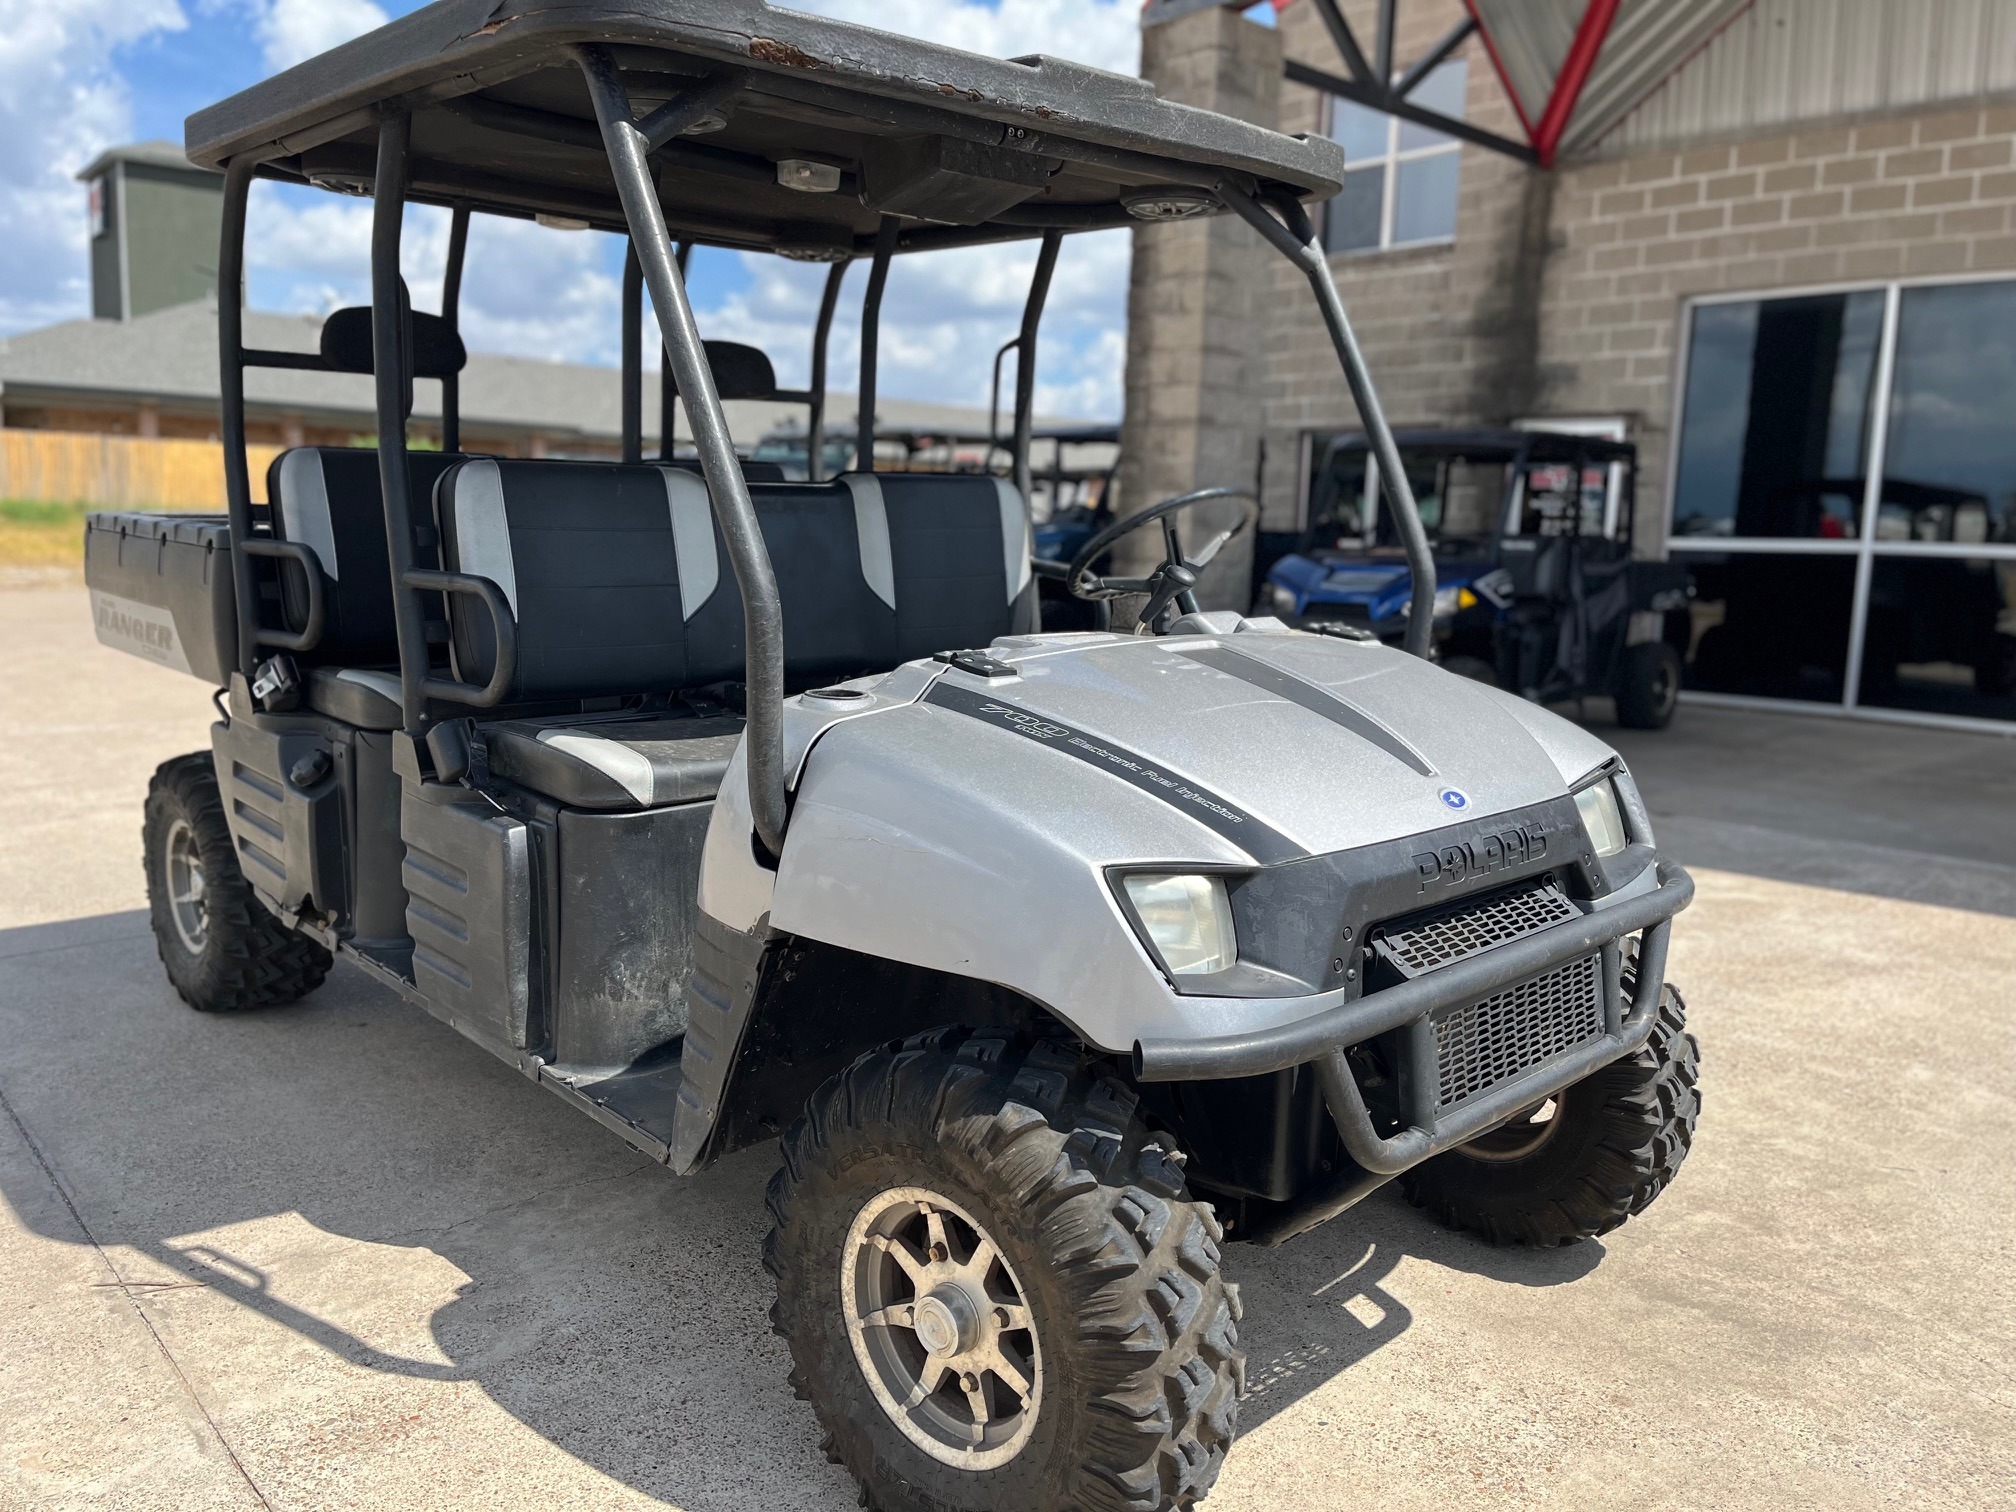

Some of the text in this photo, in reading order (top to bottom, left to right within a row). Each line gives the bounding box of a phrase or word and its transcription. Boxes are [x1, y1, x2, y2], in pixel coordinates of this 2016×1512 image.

[98, 605, 173, 651] RANGER
[979, 703, 1069, 737] 700
[1068, 737, 1242, 823] Electronic Fuel Injection
[1411, 822, 1547, 894] POLARIS
[825, 1142, 896, 1181] VERSA
